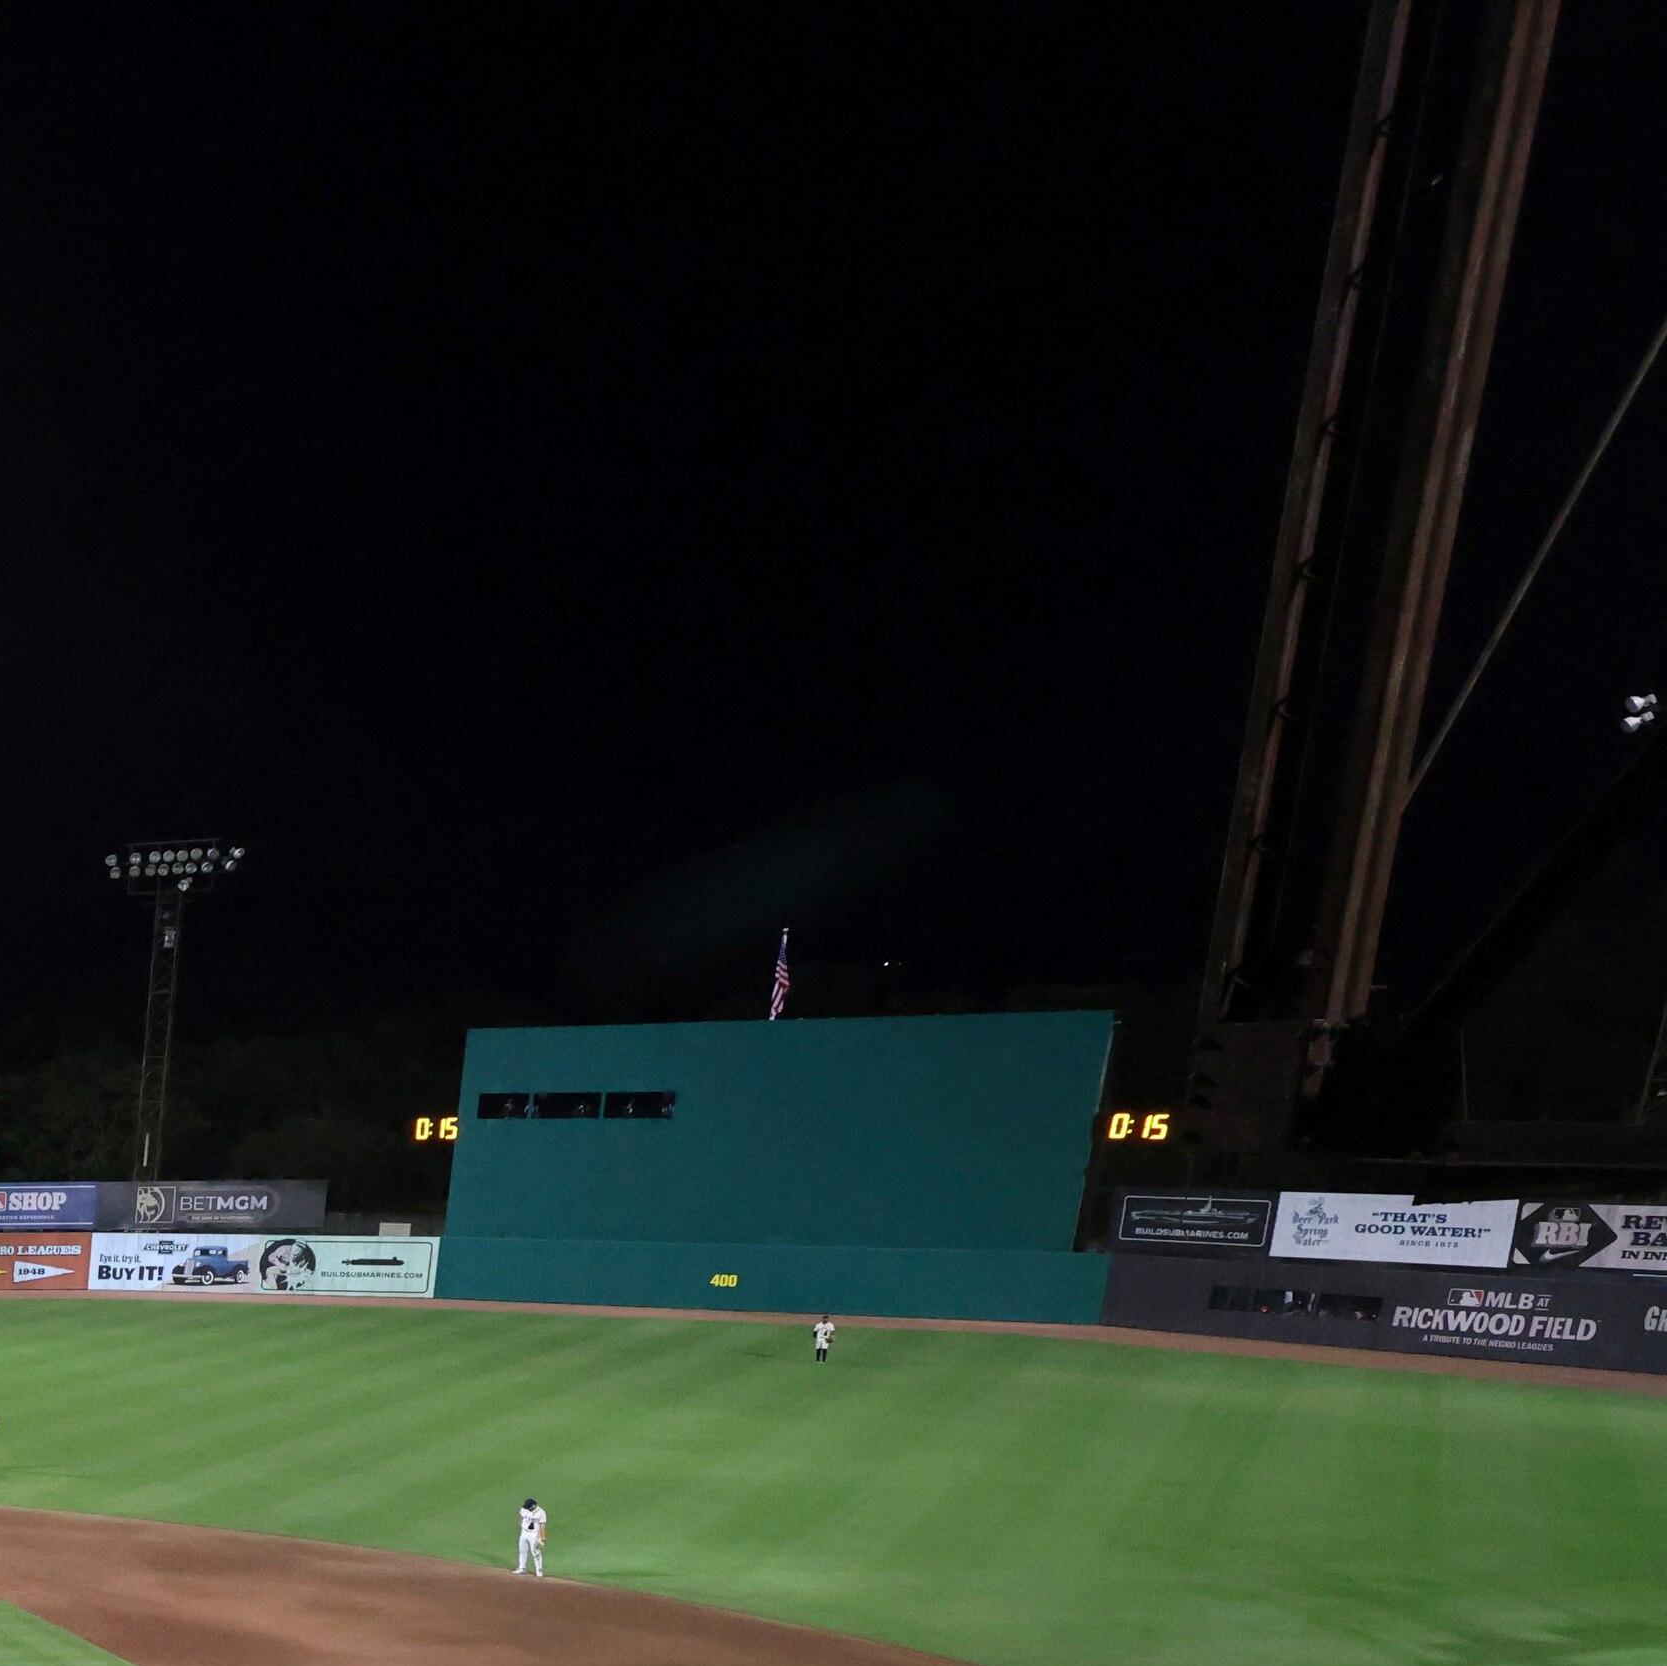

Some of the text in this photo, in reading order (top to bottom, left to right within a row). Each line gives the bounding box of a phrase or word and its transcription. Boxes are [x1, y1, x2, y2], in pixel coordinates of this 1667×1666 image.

[415, 1117, 458, 1140] 0:15
[1109, 1112, 1169, 1140] 0:15
[8, 1191, 67, 1211] SHOP
[180, 1195, 268, 1211] BETMGM
[1292, 1211, 1339, 1224] Deer Park
[1135, 1227, 1250, 1240] BUILDSUBMARINES.COM
[1296, 1224, 1329, 1239] Spring
[1354, 1223, 1406, 1235] GOOD
[1535, 1221, 1592, 1246] RBI
[146, 1243, 188, 1251] CHEVROLET
[1293, 1235, 1325, 1247] Water
[1399, 1240, 1431, 1248] SINCE
[17, 1245, 82, 1255] LEAGUES
[1620, 1250, 1640, 1259] IN
[99, 1254, 134, 1265] Eye try
[18, 1267, 45, 1275] 1948
[98, 1265, 164, 1281] BUY IT!
[320, 1271, 423, 1279] BUILDSUBMARINES.COM
[709, 1274, 738, 1288] 400
[1485, 1291, 1549, 1310] MLB AT
[1392, 1306, 1597, 1341] RICKWOOD FIELD
[1422, 1334, 1554, 1352] A TRIBUTE TO THE NEGRO LEAGUES
